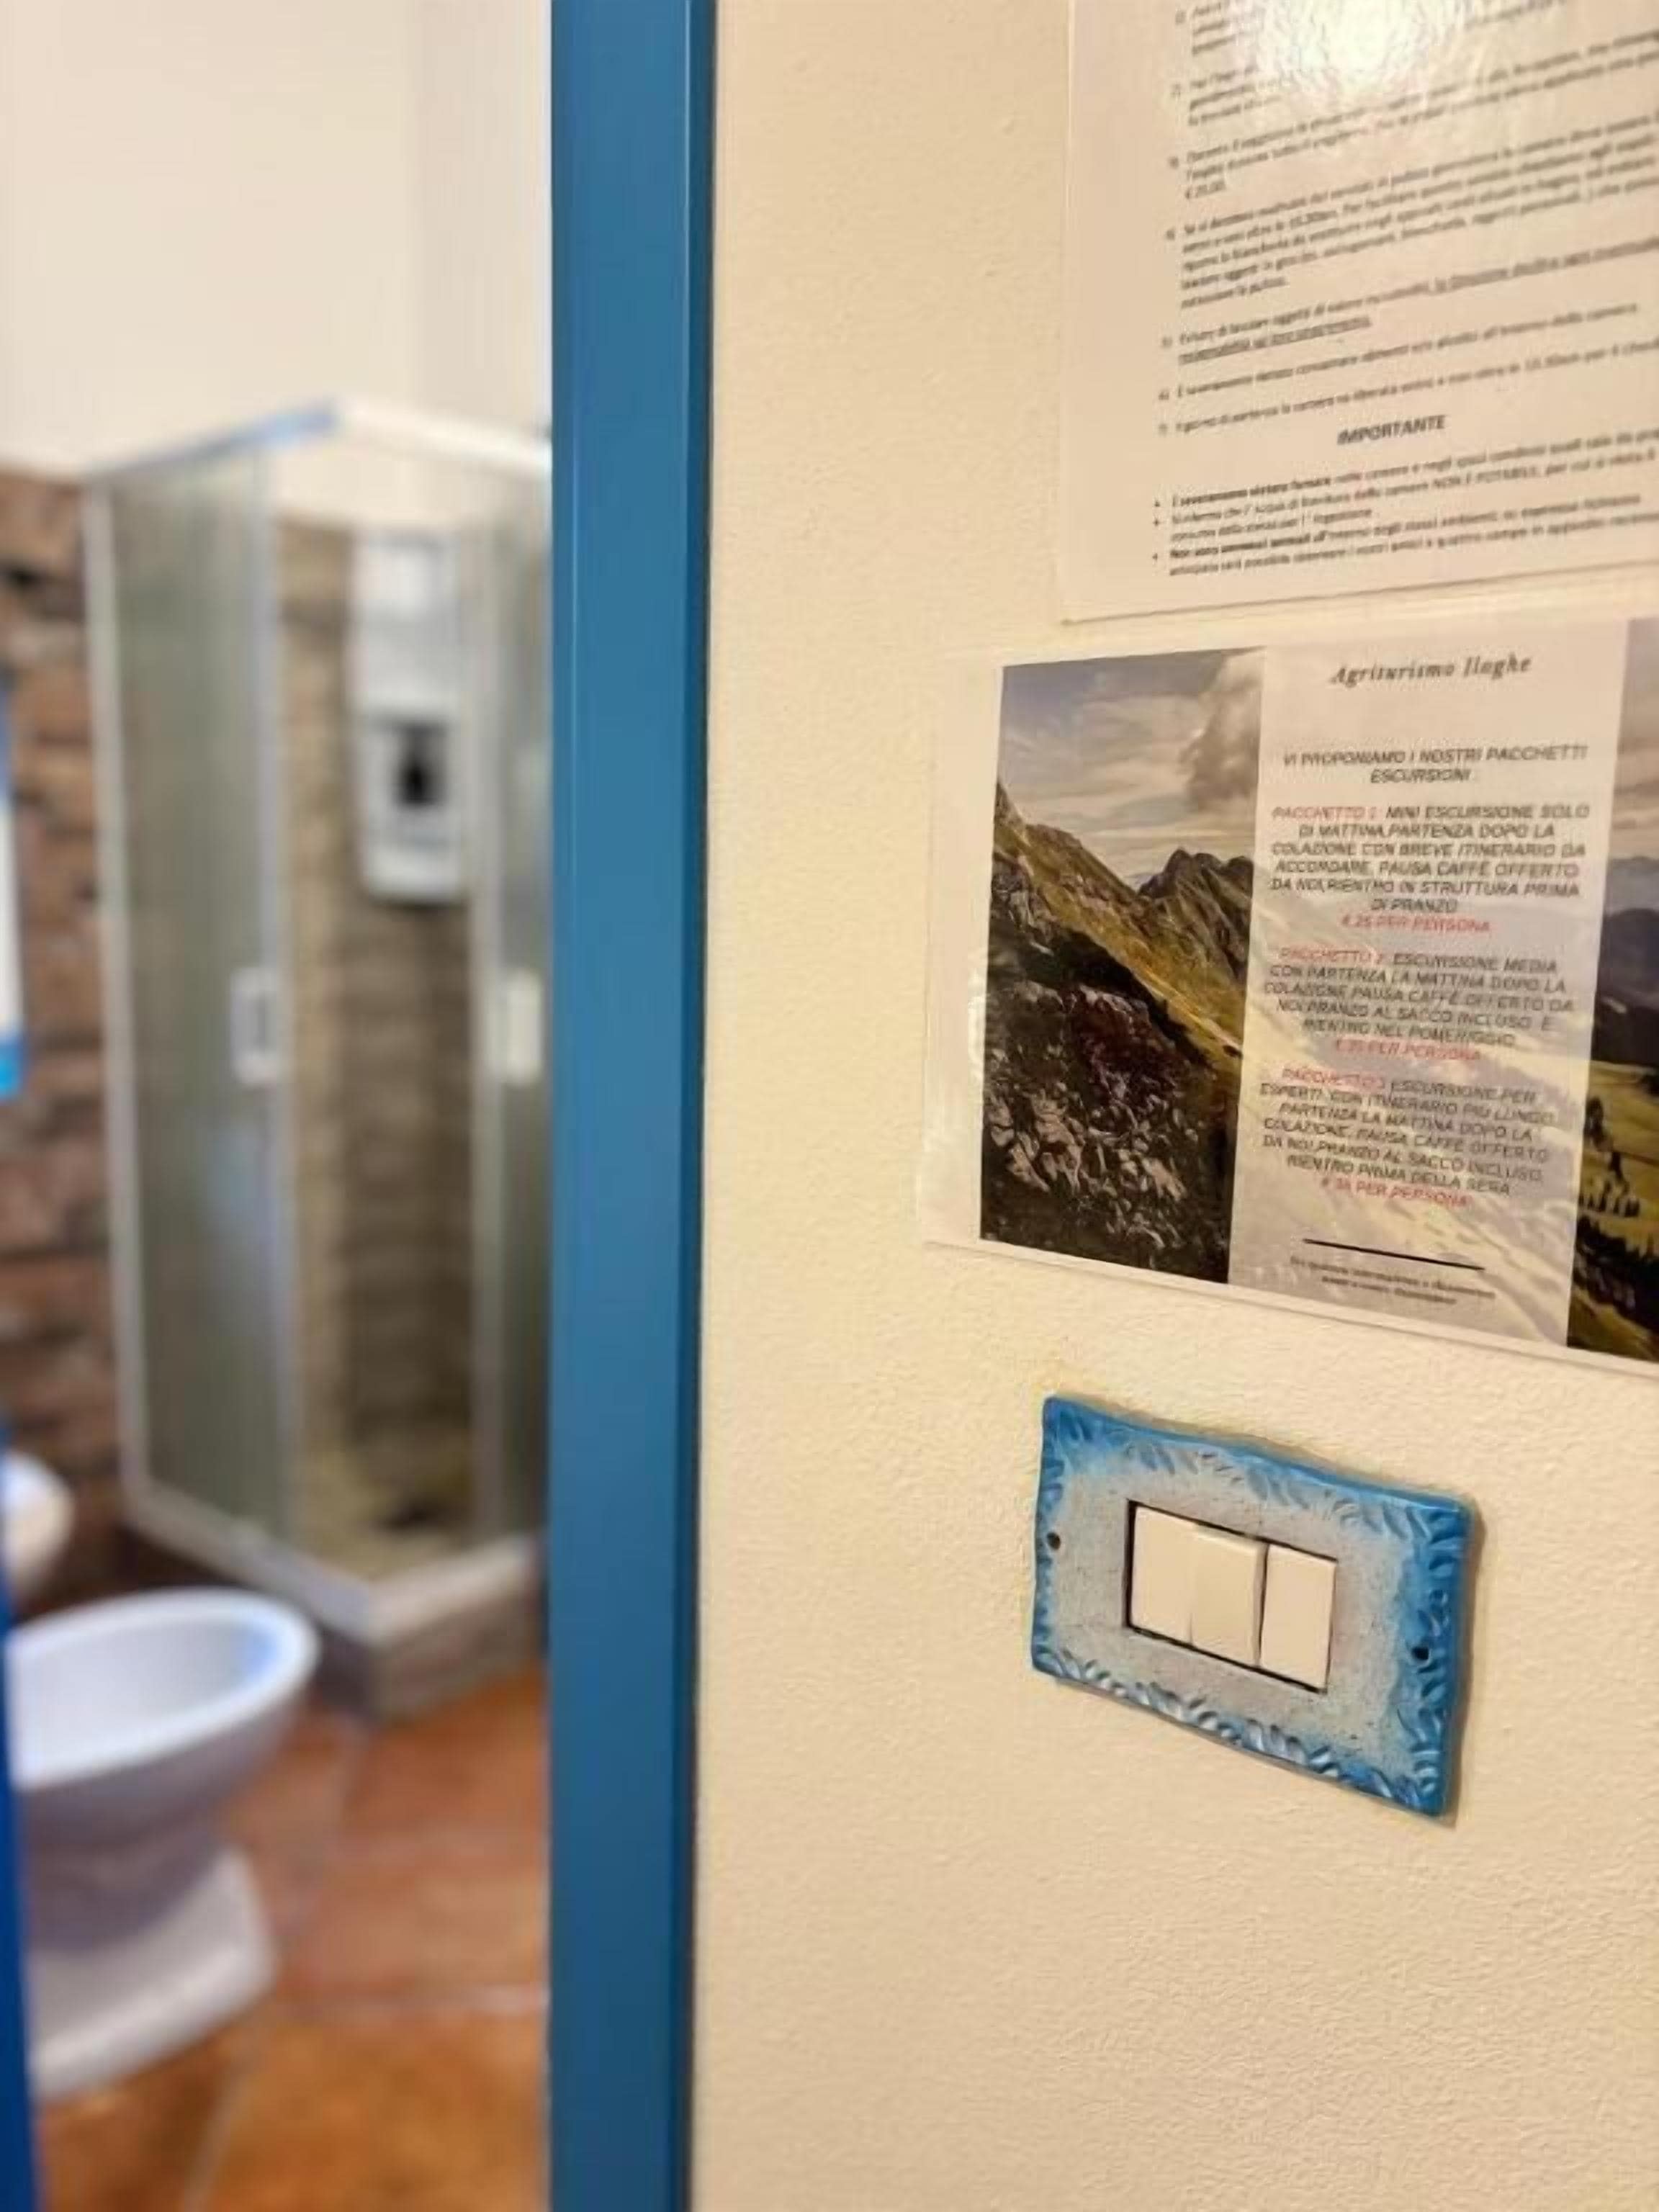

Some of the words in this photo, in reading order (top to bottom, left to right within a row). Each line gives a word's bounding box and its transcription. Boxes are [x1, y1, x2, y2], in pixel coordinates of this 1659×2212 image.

[1337, 415, 1446, 445] IMPORTANTE
[1330, 658, 1455, 688] Agriturismo
[1301, 750, 1406, 766] PROPONIAMO
[1419, 747, 1483, 764] NOSTRI
[1485, 745, 1588, 762] PACCHETTI
[1271, 805, 1366, 819] PACCHETTO
[1386, 804, 1420, 819] MINI
[1425, 805, 1533, 819] ESCURSIONE
[1541, 804, 1590, 819] SOLO
[1299, 823, 1313, 838] DI
[1480, 822, 1529, 838] DOPO
[1534, 823, 1554, 838] LA
[1271, 841, 1357, 856] COLAZIONE
[1362, 842, 1394, 856] CON
[1399, 842, 1452, 857] BREVE
[1458, 842, 1555, 858] ITINERARIO
[1561, 842, 1586, 858] DA
[1379, 860, 1431, 876] PAUSA
[1496, 862, 1580, 878] OFFERTO
[1270, 878, 1291, 891] DA
[1399, 881, 1414, 893] IN
[1420, 881, 1519, 896] STRUTTURA
[1524, 883, 1581, 897] PRIMA
[1371, 898, 1386, 911] DI
[1390, 899, 1458, 914] PRANZO
[1376, 915, 1408, 928] PER
[1413, 917, 1490, 932] PERSONA
[1393, 953, 1499, 971] ESCURSIONE
[1503, 957, 1557, 974] MEDIA
[1270, 964, 1303, 977] CON
[1307, 966, 1387, 984] PARTENZA
[1390, 971, 1409, 984] LA
[1416, 971, 1485, 989] MATTINA
[1490, 975, 1539, 992] DOPO
[1543, 978, 1567, 994] LA
[1352, 986, 1403, 1001] PAUSA
[1466, 994, 1545, 1012] OFFERTO
[1549, 998, 1575, 1012] DA
[1373, 1007, 1395, 1019] AL
[1398, 1007, 1453, 1023] SACCO
[1303, 1018, 1370, 1035] RIENTRO
[1374, 1022, 1403, 1038] NEL
[1408, 1025, 1516, 1046] POMERIGGIO
[1403, 1044, 1480, 1061] PERSONA
[1391, 1079, 1498, 1100] ESCURSIONE
[1501, 1087, 1537, 1104] PER
[1367, 1094, 1458, 1115] ITINERARIO
[1280, 1102, 1358, 1121] PARTENZA
[1362, 1111, 1381, 1124] LA
[1385, 1114, 1454, 1133] MATTINA
[1460, 1123, 1507, 1139] DOPO
[1513, 1128, 1533, 1142] LA
[1264, 1135, 1282, 1148] DA
[1382, 1150, 1402, 1164] AL
[1408, 1152, 1465, 1173] SACCO
[1356, 1128, 1407, 1146] PAUSA
[1470, 1142, 1550, 1164] OFFERTO
[1287, 1154, 1354, 1174] RIENTRO
[1359, 1163, 1406, 1180] PRIMA
[1411, 1171, 1461, 1190] DELLA
[1466, 1177, 1511, 1196] SERA
[1357, 1179, 1387, 1196] PER
[1389, 1184, 1470, 1207] PERSONA
